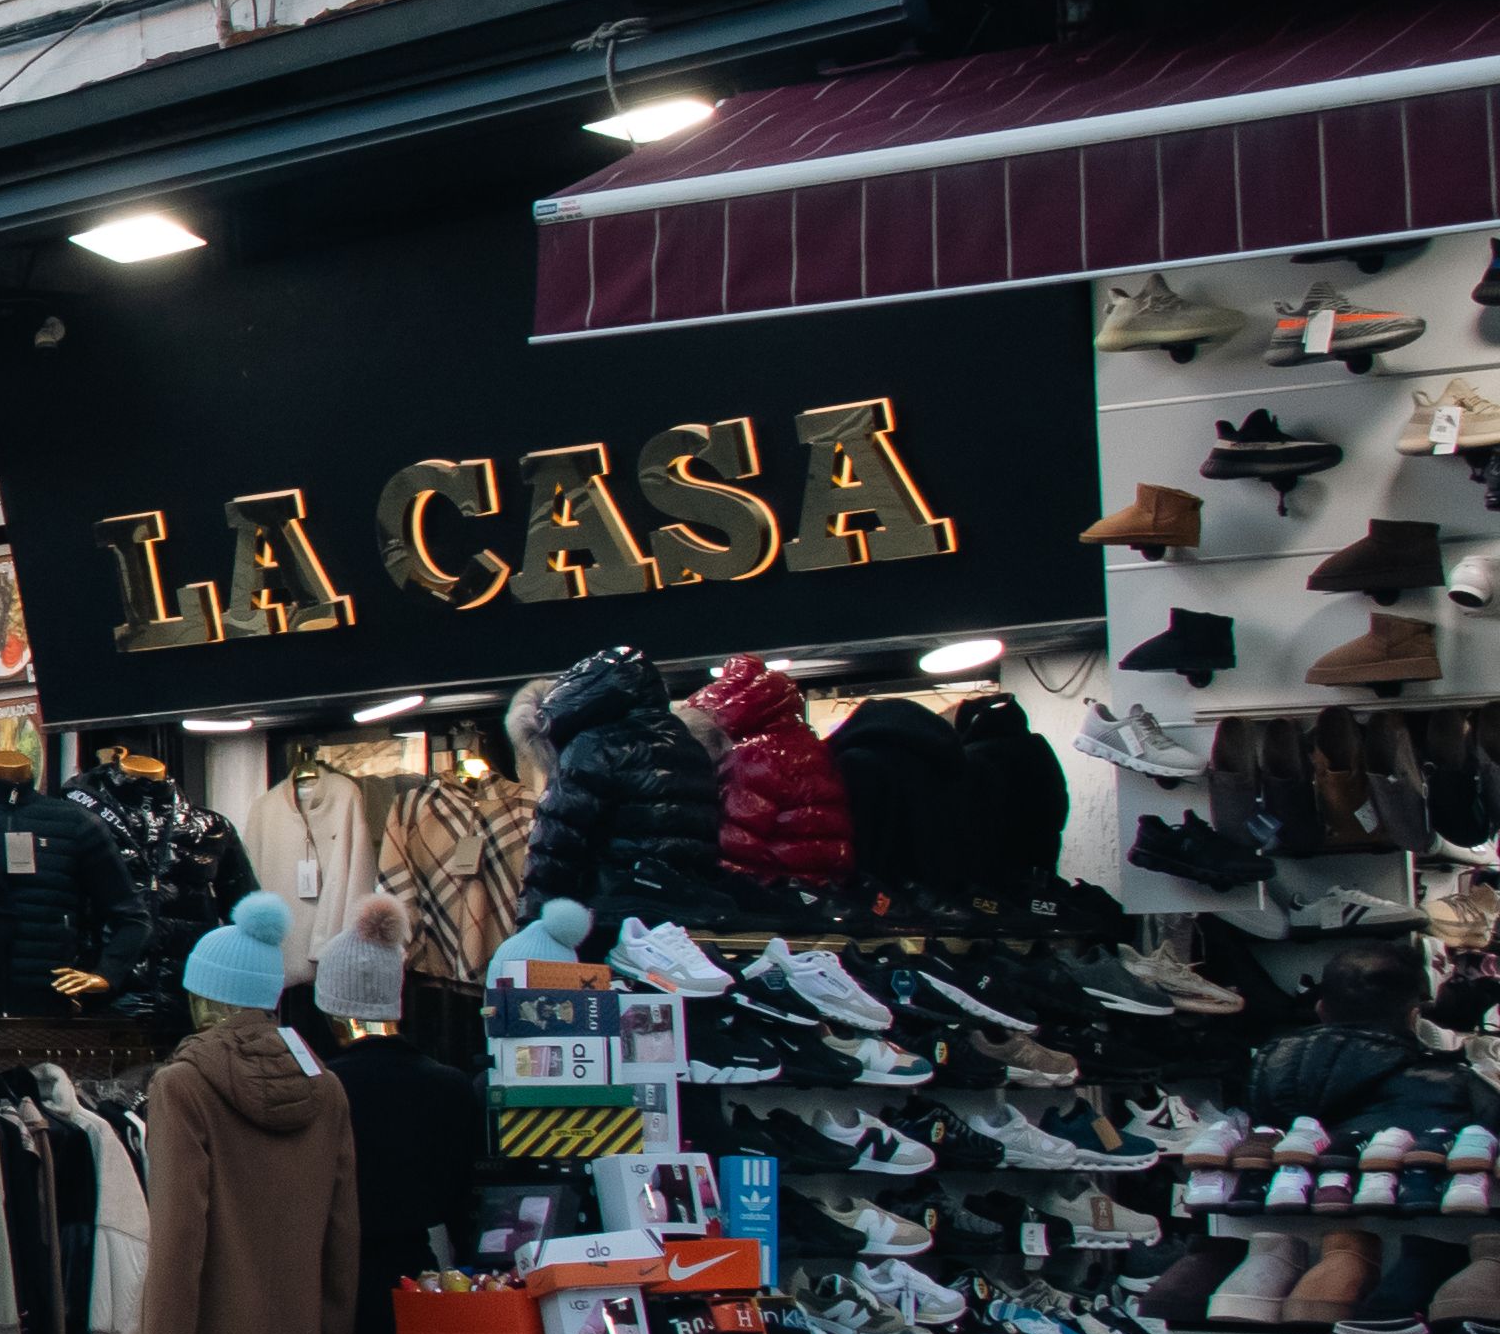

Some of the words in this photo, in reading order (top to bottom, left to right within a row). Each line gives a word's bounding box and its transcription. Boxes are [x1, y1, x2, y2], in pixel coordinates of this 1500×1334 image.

[96, 488, 356, 652] LA
[377, 397, 957, 611] CASA
[1031, 899, 1057, 912] EA7
[587, 996, 598, 1031] POLO
[572, 1043, 595, 1079] alo
[585, 1240, 611, 1259] alo
